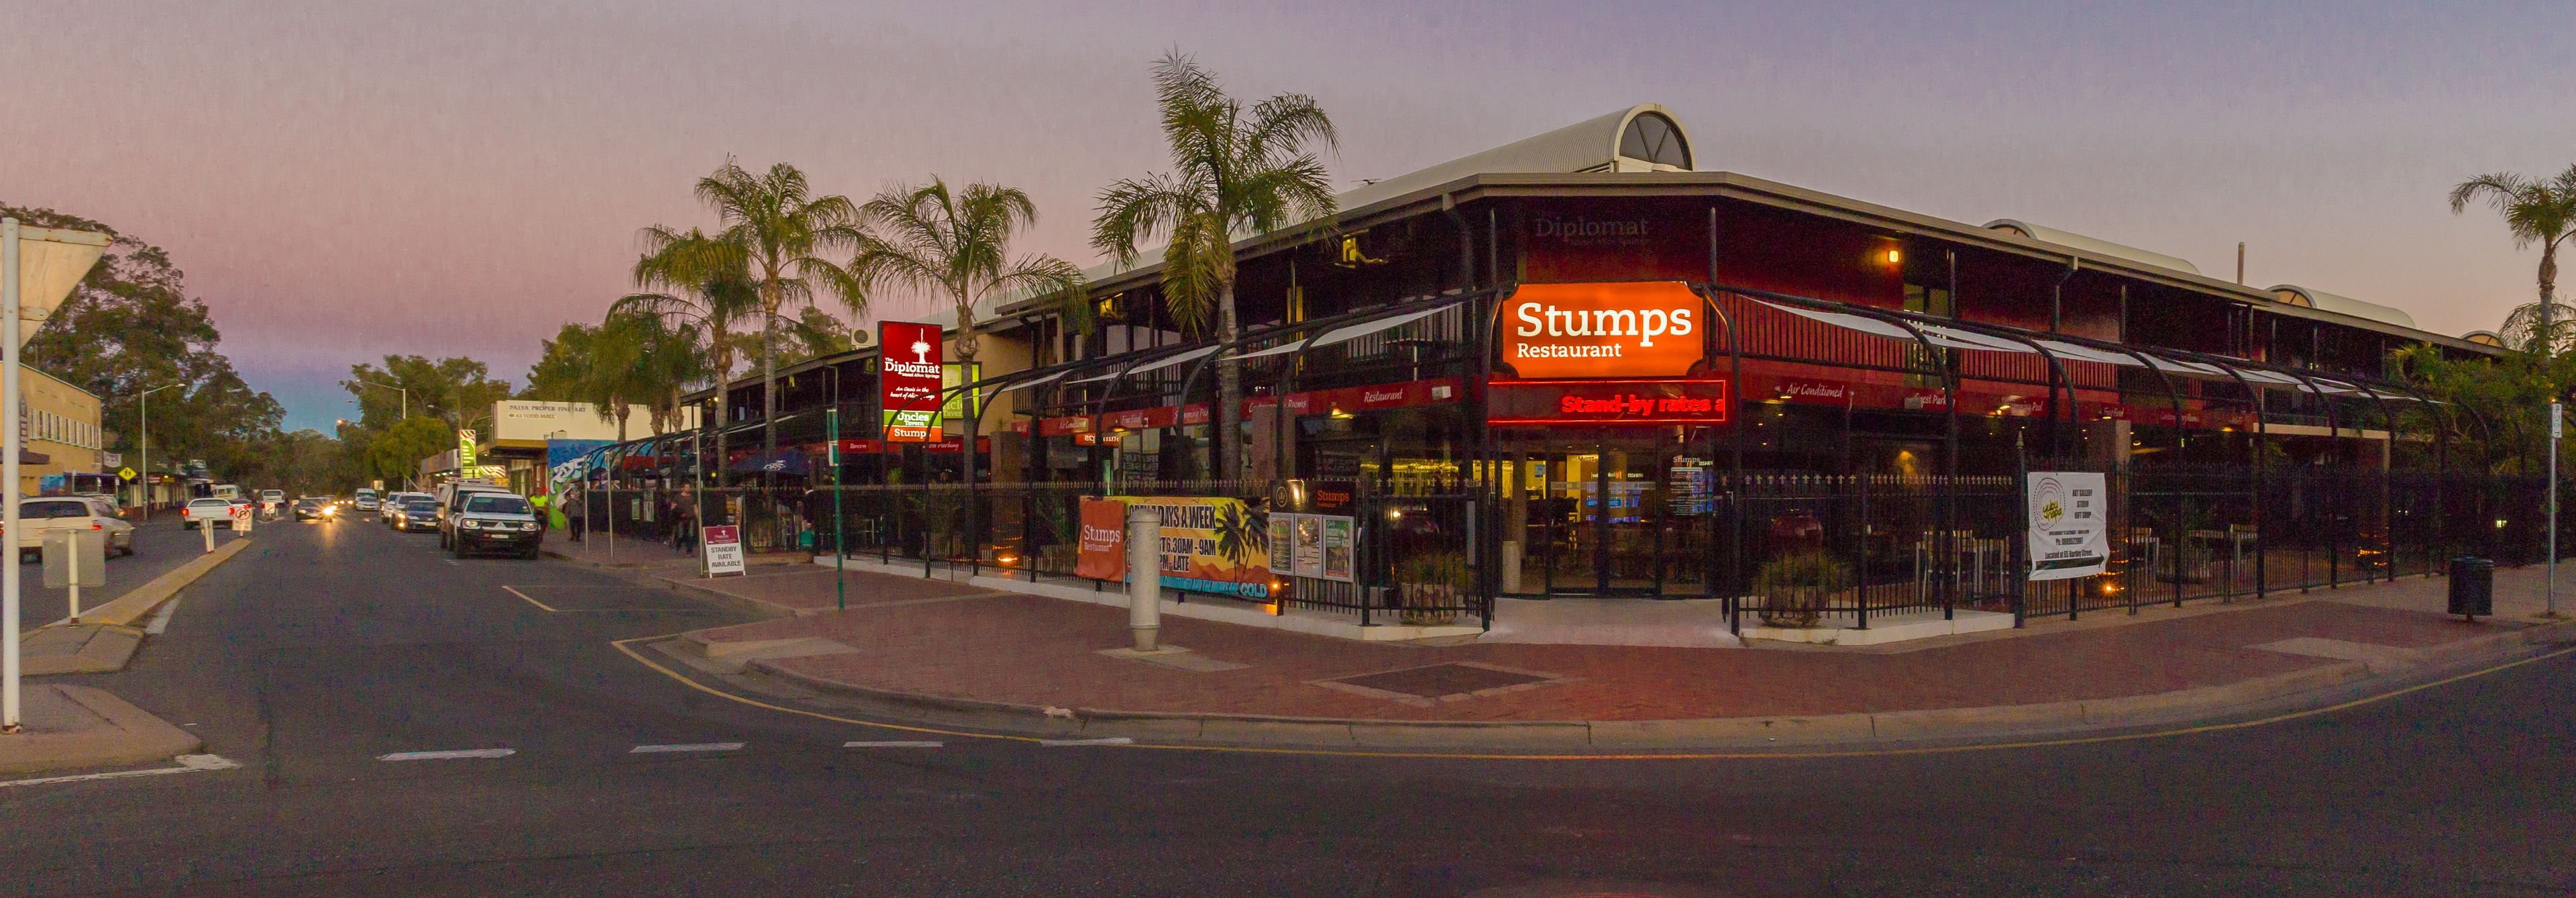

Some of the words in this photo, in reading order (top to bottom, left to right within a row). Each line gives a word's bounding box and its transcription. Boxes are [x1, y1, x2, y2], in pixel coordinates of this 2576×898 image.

[1534, 215, 1648, 242] Diplomat
[1517, 302, 1693, 348] Stumps
[1517, 343, 1622, 358] Restaurant
[885, 361, 940, 375] Diplomat
[902, 392, 909, 400] of
[1364, 389, 1403, 403] Restaurant
[1787, 383, 1801, 395] Air
[1801, 383, 1844, 398] Conditioned
[1562, 395, 1655, 416] Stand-by
[1659, 396, 1711, 413] rates
[897, 412, 929, 421] Uncles
[894, 428, 932, 439] Stump
[1318, 490, 1350, 505] Stumps
[1158, 505, 1180, 528] DAYS
[1181, 505, 1187, 528] A
[1189, 506, 1216, 529] WEEK
[1084, 524, 1120, 548] Stumps
[711, 546, 737, 554] STANDBY
[1167, 537, 1193, 554] 6.30AM
[1199, 539, 1216, 556] 9AM
[711, 560, 741, 568] AVAILABLE
[1173, 555, 1189, 571] LATE
[1240, 583, 1268, 598] COLD
